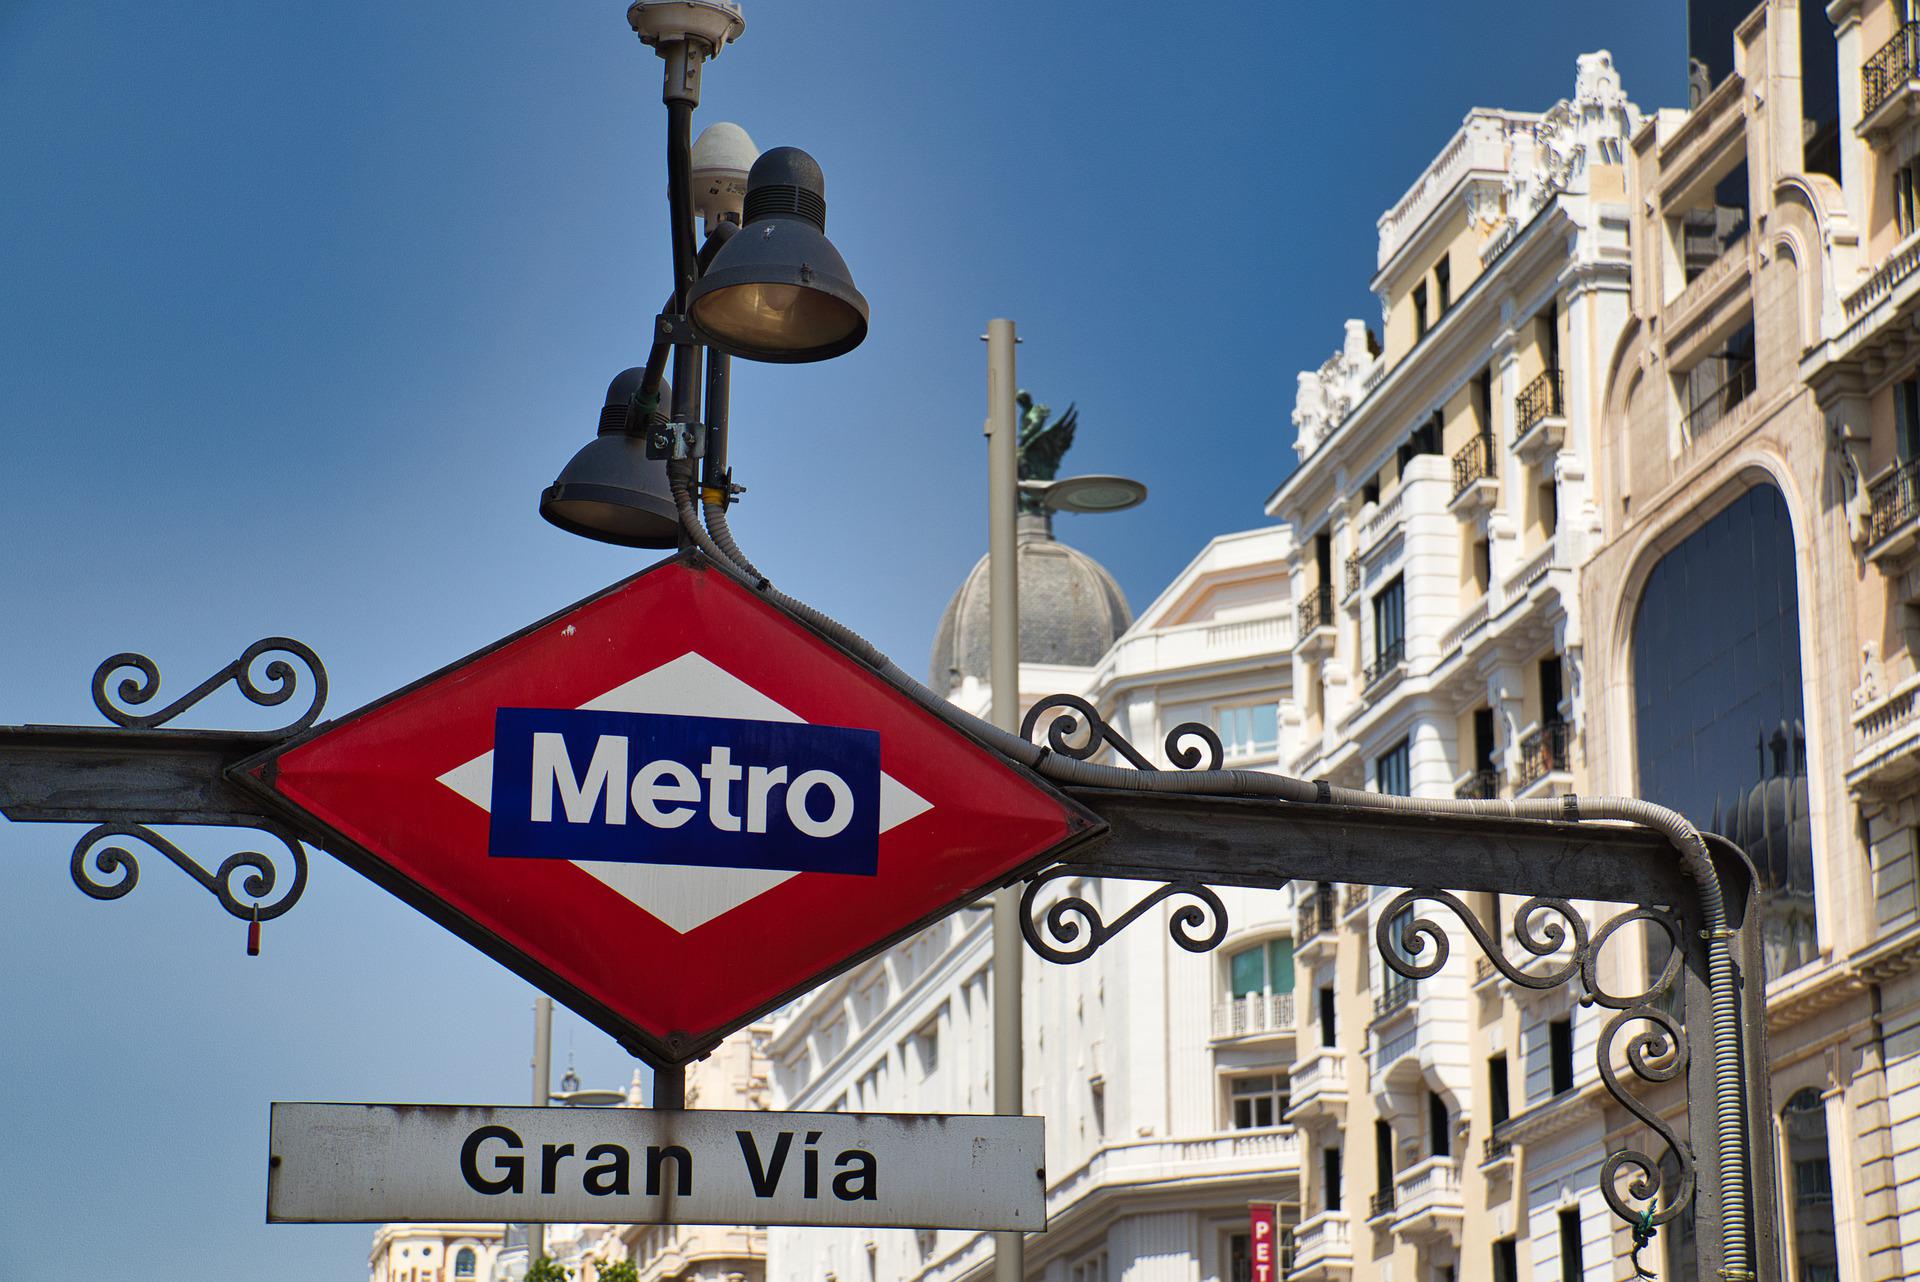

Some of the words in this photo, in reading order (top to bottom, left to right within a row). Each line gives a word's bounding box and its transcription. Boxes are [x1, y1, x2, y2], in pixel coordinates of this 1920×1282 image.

[530, 732, 855, 838] Metro
[459, 1125, 693, 1198] Gran
[735, 1130, 879, 1202] Vía
[1255, 1221, 1270, 1282] PET
